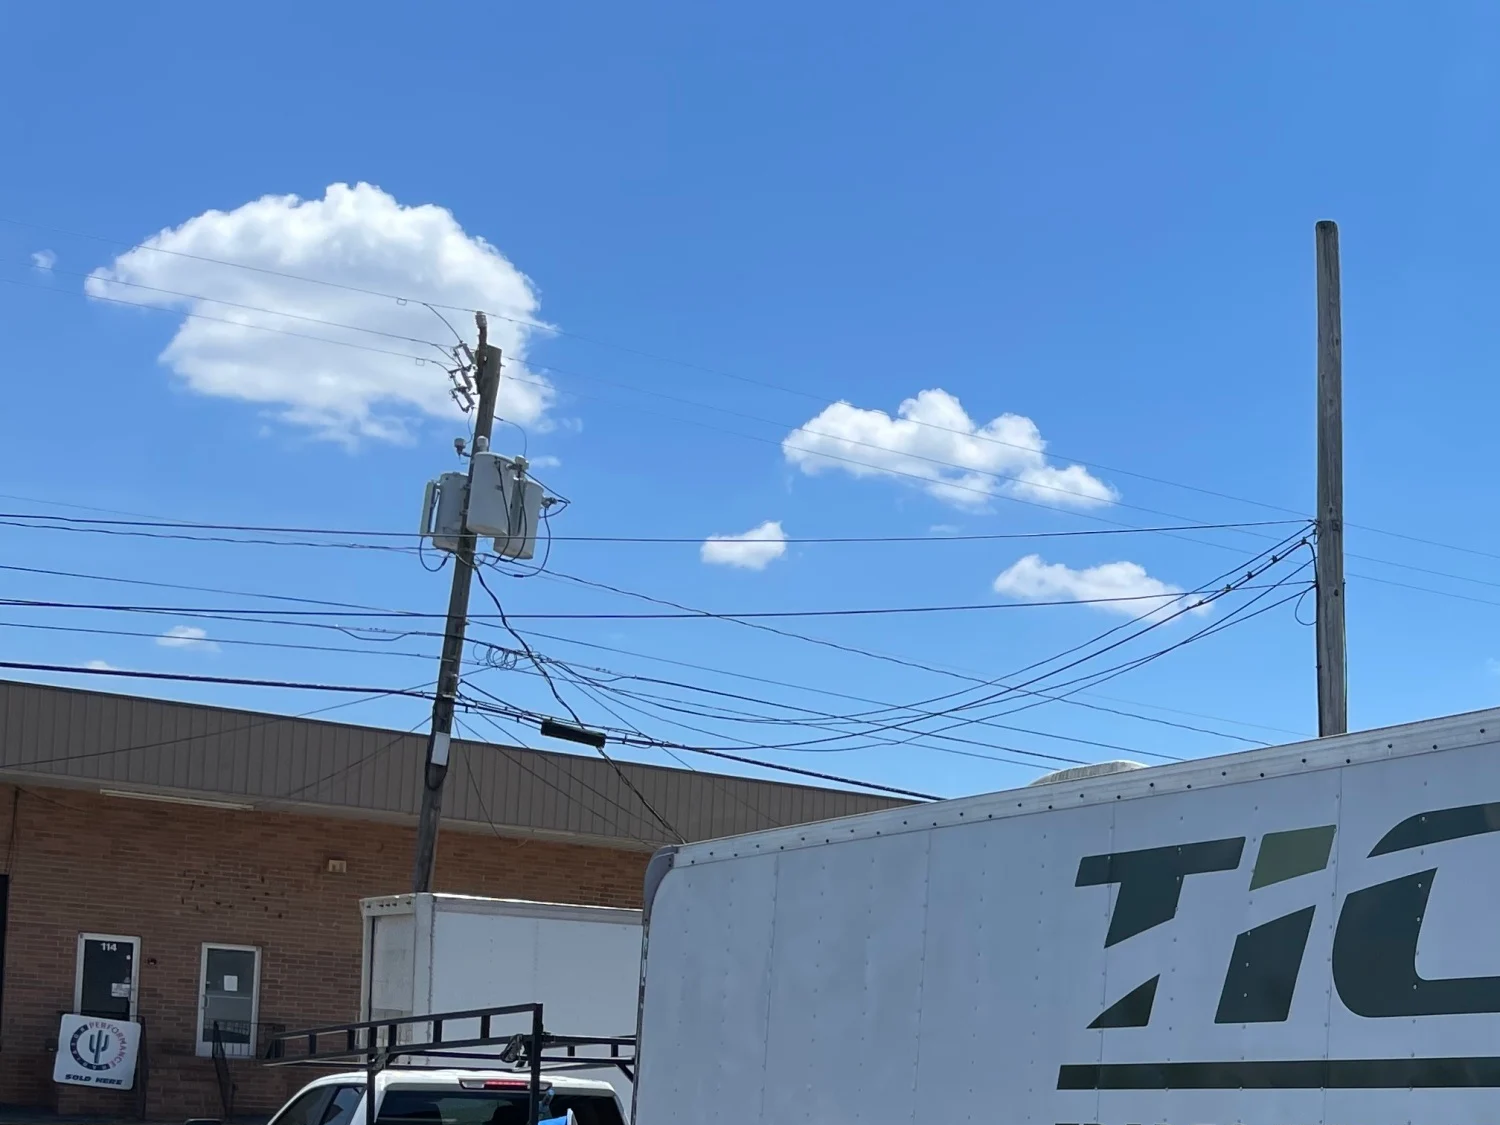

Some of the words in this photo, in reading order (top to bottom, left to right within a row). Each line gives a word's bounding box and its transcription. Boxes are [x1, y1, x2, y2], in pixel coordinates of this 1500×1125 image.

[101, 942, 117, 952] 114
[88, 1021, 127, 1068] PERFORMANCE
[65, 1073, 92, 1082] SOLD
[95, 1077, 123, 1085] HERE
